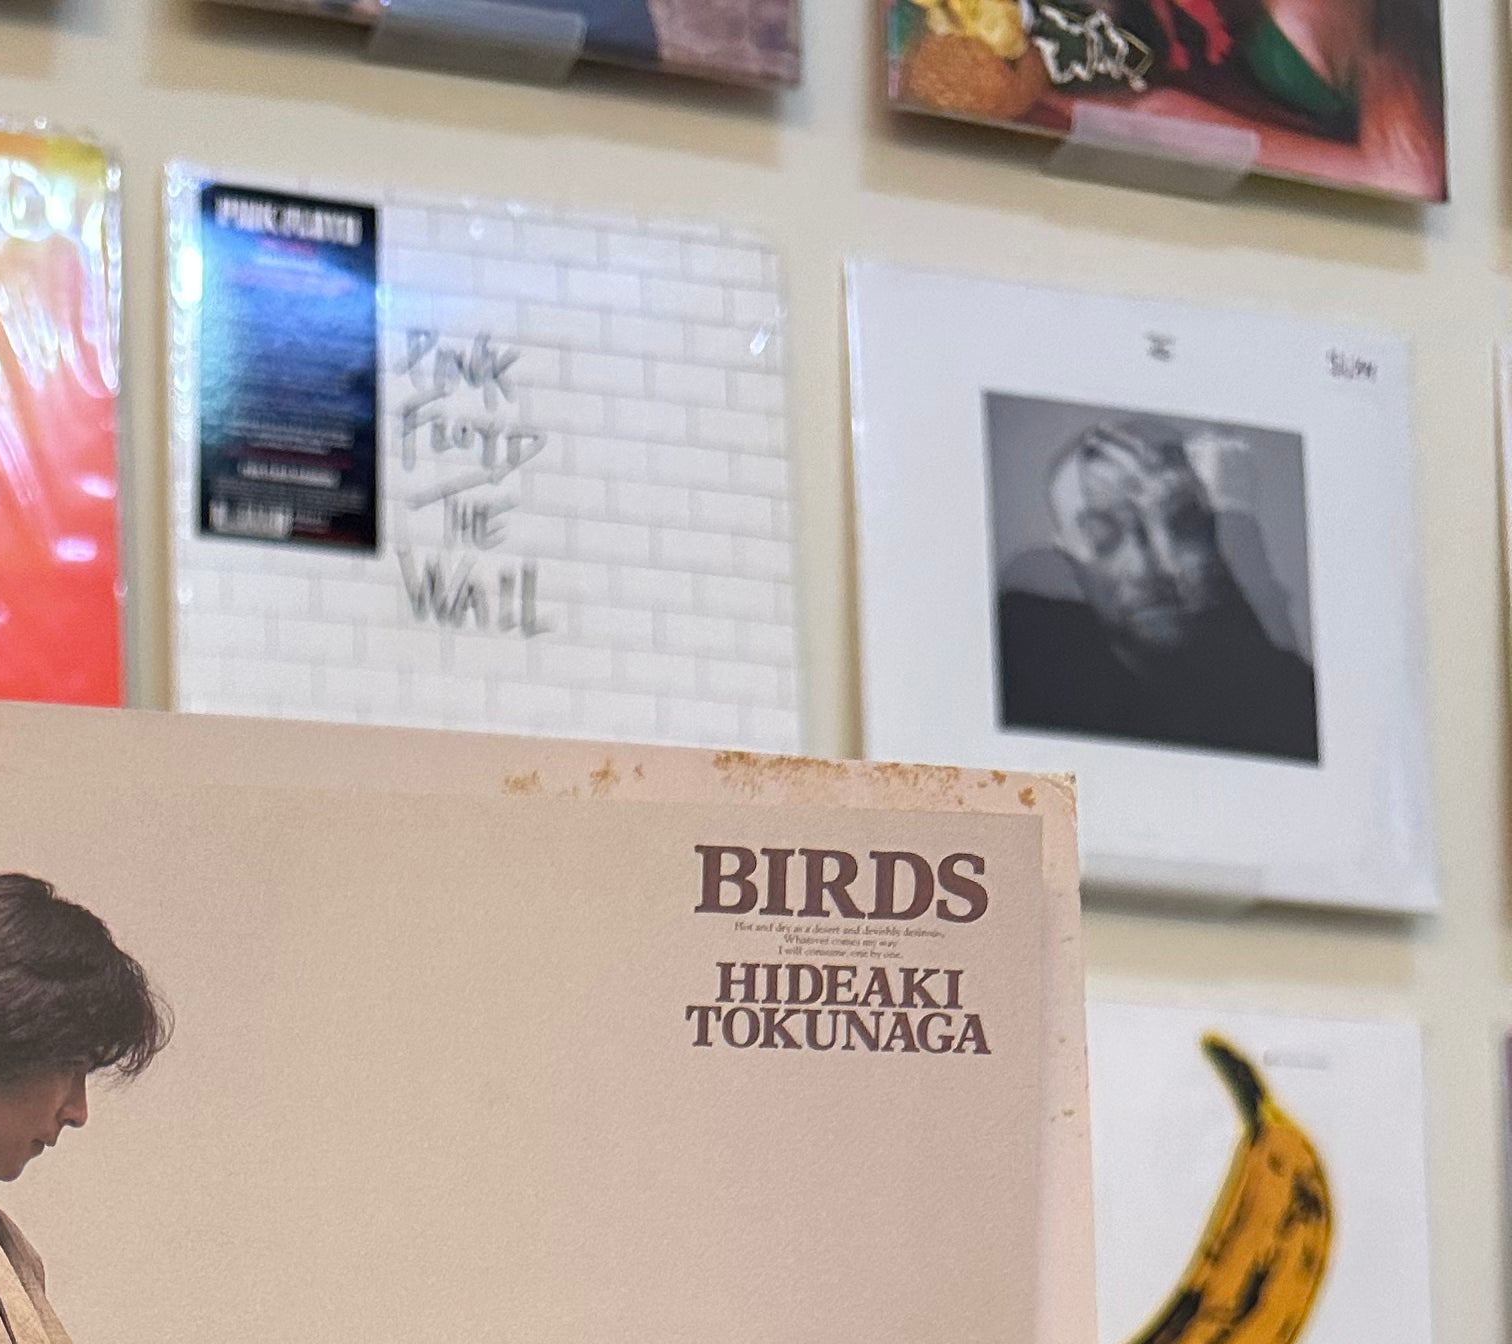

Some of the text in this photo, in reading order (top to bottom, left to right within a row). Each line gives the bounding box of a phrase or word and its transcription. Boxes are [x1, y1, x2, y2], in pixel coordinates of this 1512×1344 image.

[694, 845, 989, 923] BIRDS
[715, 961, 963, 1010] HIDEAKI
[685, 1005, 991, 1055] TOKUNAGA
